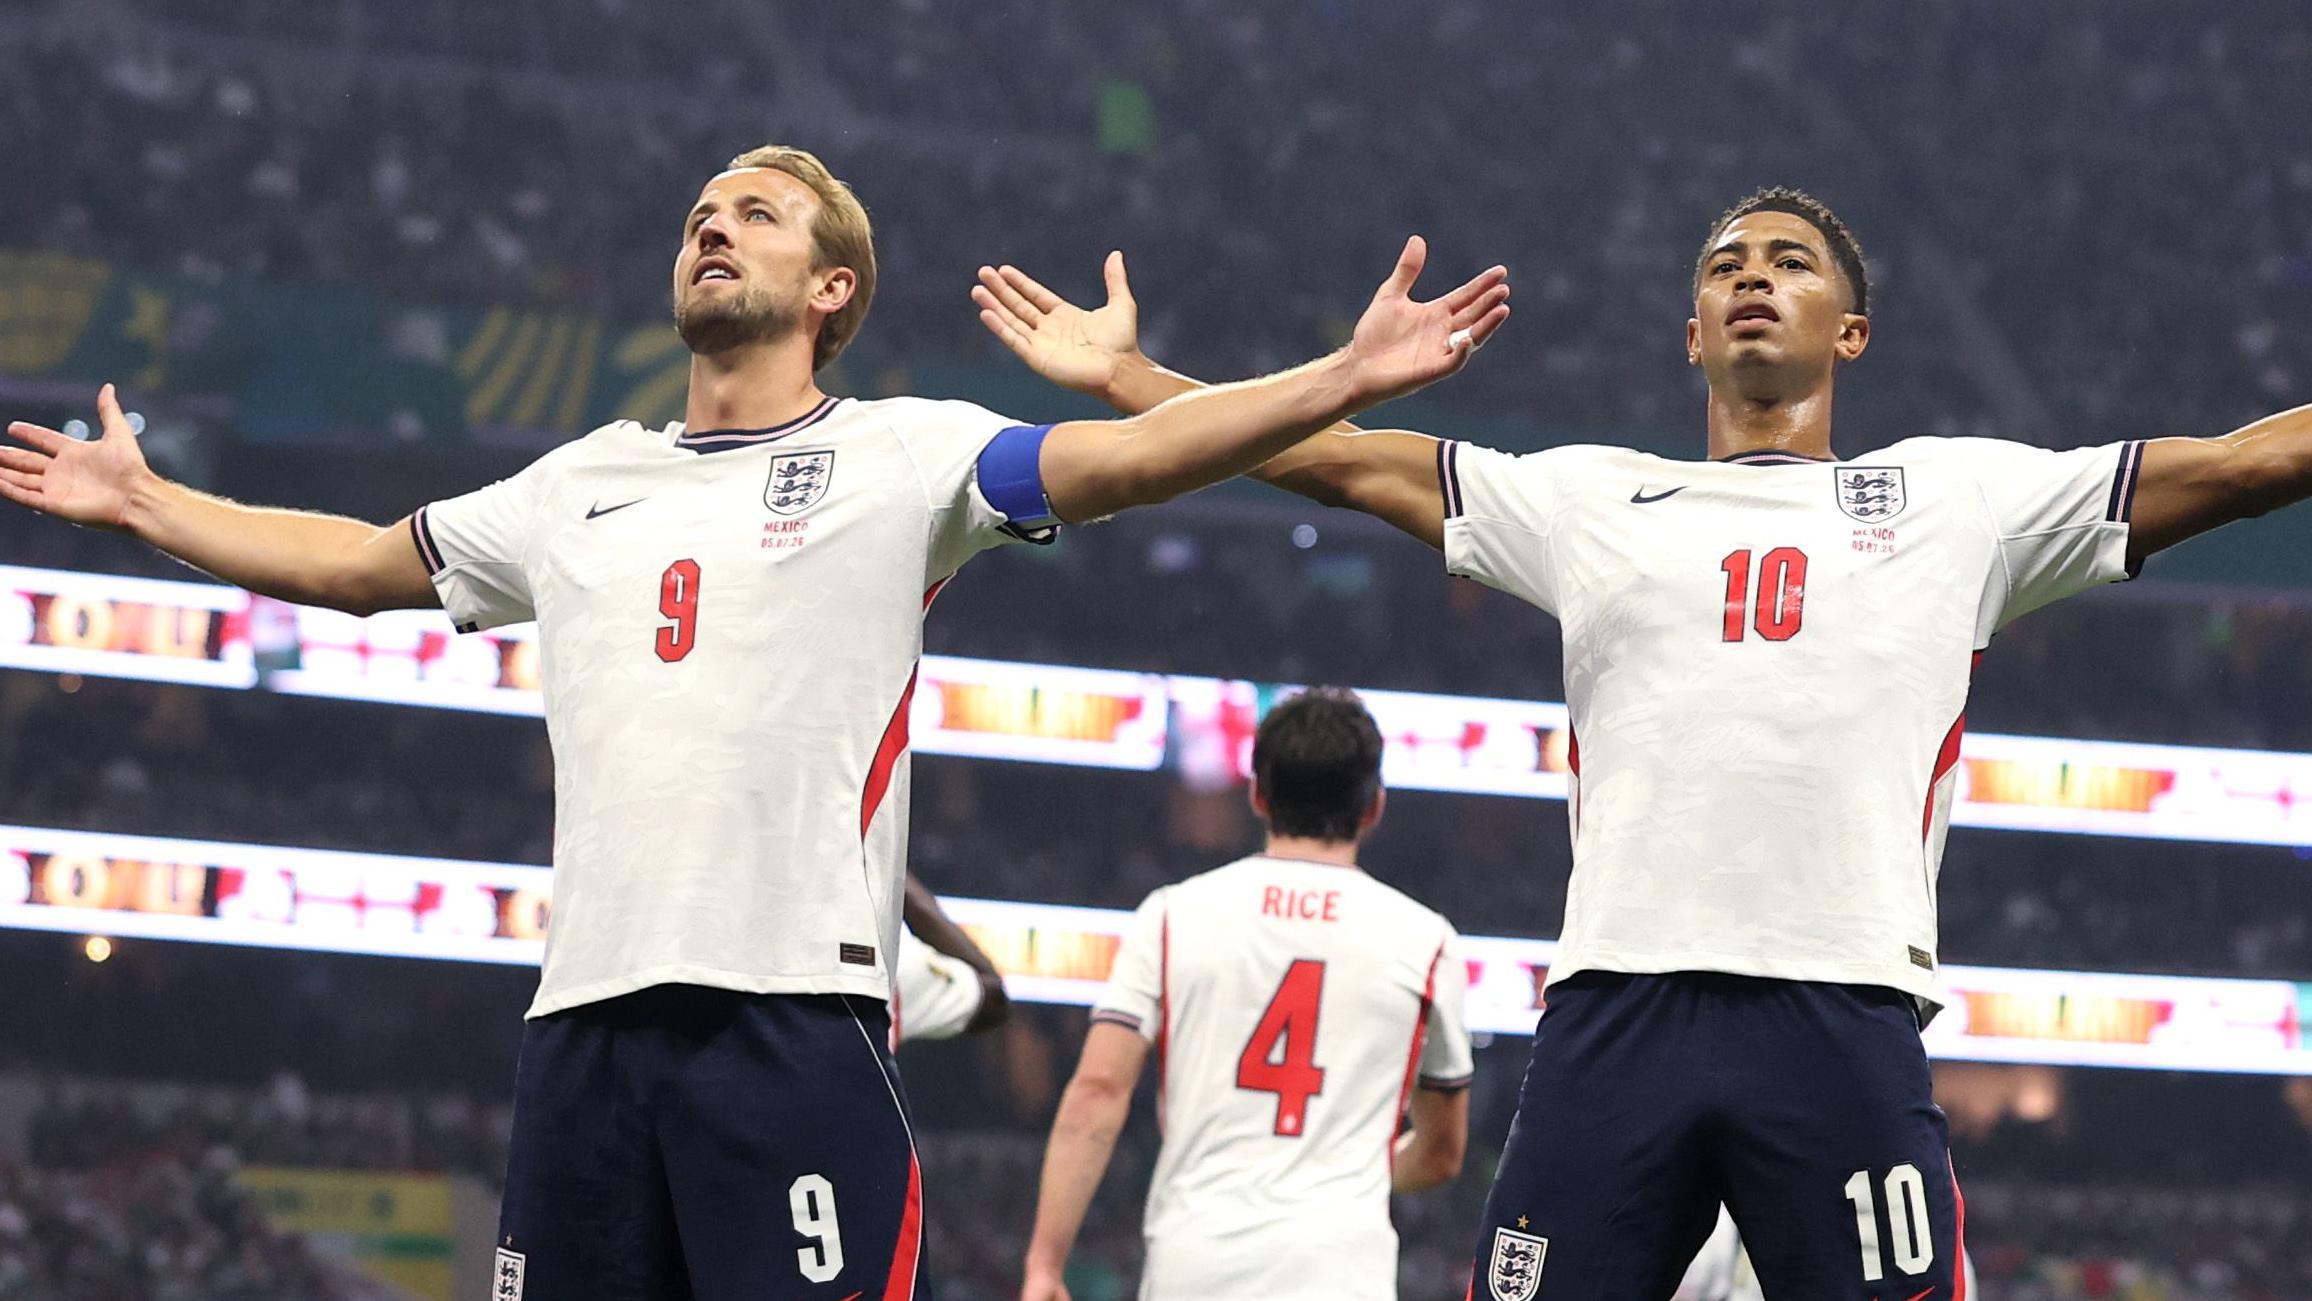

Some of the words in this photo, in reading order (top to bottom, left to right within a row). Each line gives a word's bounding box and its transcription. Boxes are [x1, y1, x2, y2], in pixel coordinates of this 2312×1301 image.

[763, 520, 808, 533] MEXICO
[1852, 528, 1895, 541] MEXICO
[655, 559, 700, 663] 9
[1721, 547, 1808, 642] 10
[1262, 885, 1341, 922] RICE
[1235, 958, 1325, 1137] 4
[789, 1174, 844, 1283] 9
[1845, 1164, 1934, 1281] 10
